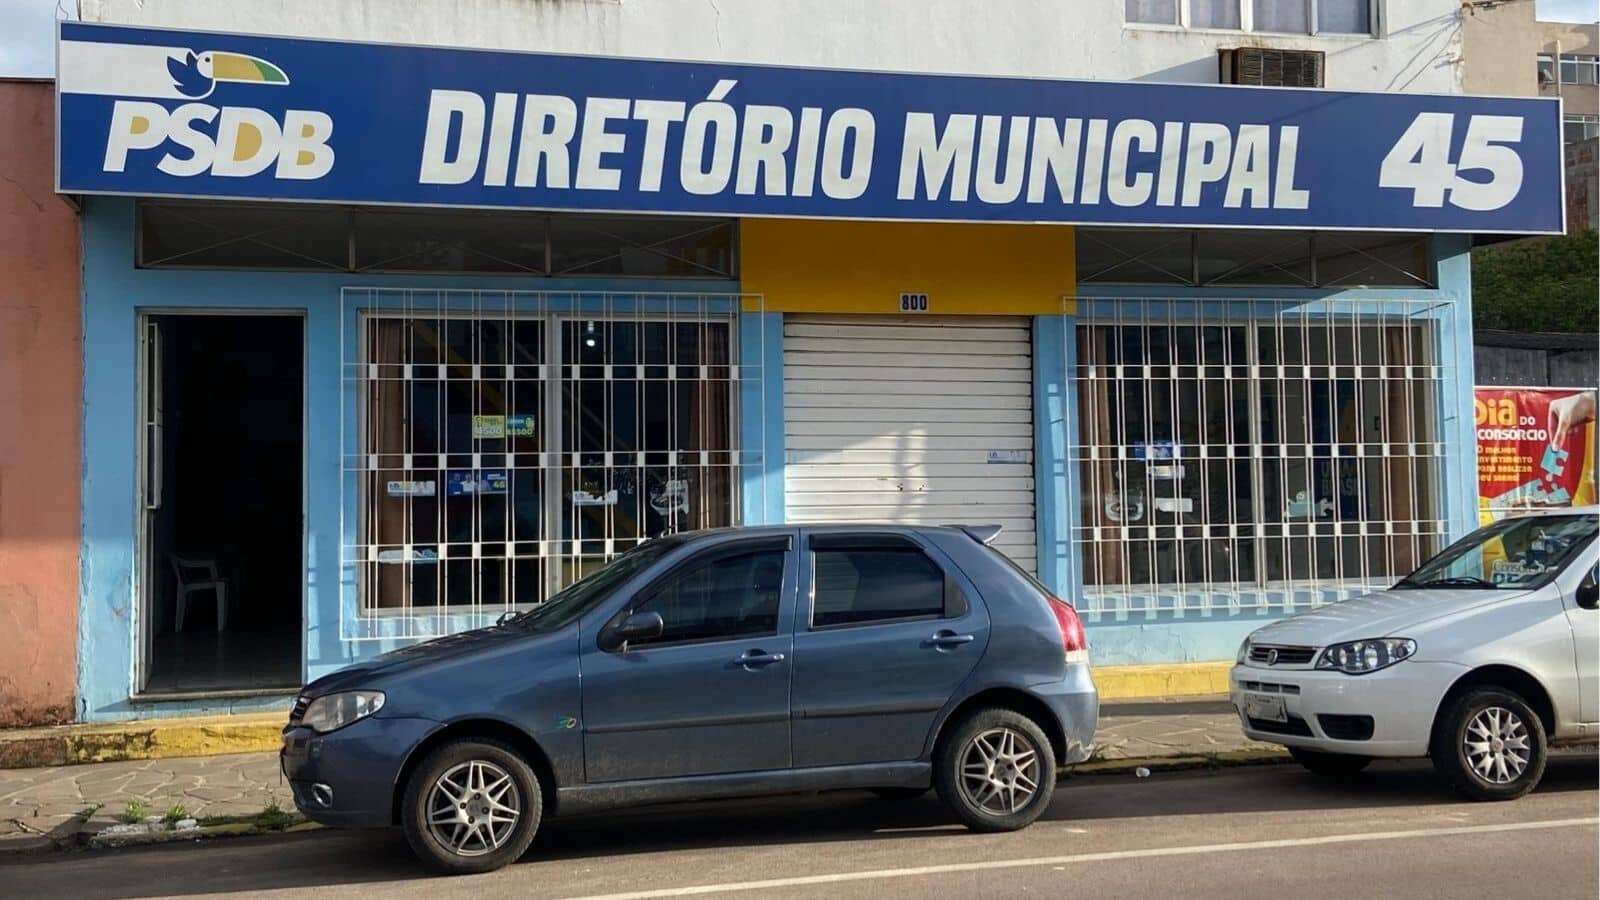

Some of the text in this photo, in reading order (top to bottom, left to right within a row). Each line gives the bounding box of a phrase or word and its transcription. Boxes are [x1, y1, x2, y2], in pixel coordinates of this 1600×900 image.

[103, 100, 335, 179] PSDB
[419, 80, 1524, 209] DIRETÓRIO MUNICIPAL 45
[902, 294, 927, 310] 800
[1520, 416, 1536, 426] DO
